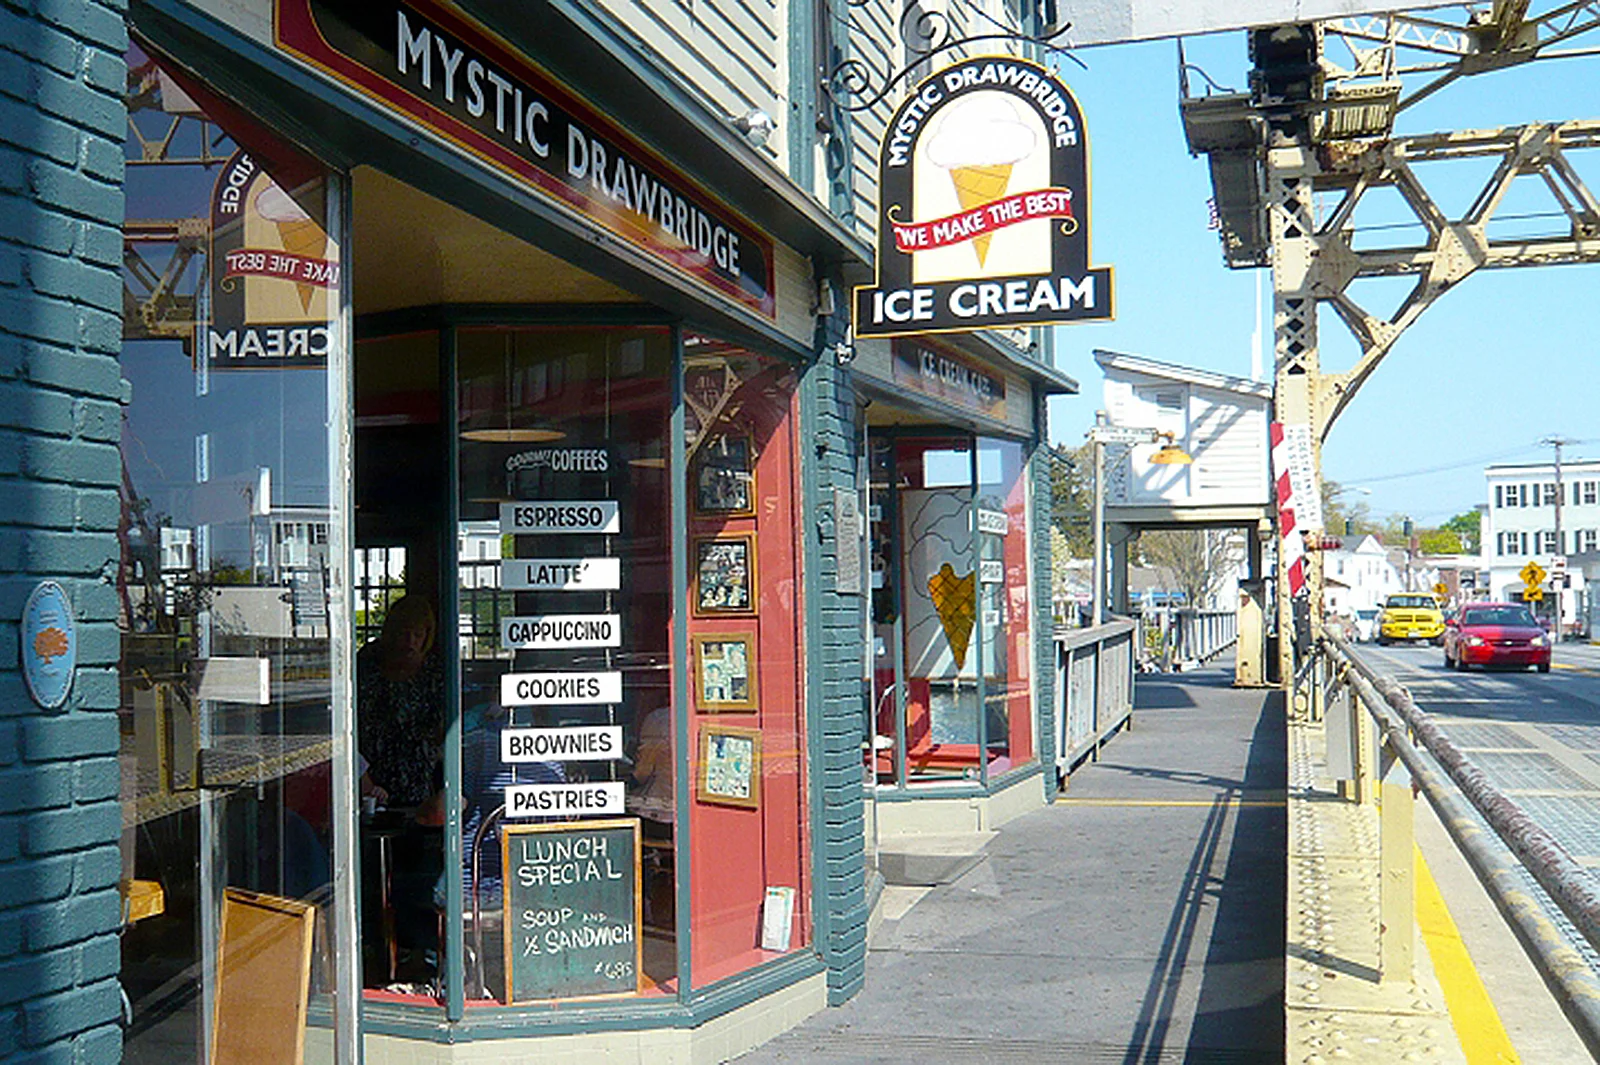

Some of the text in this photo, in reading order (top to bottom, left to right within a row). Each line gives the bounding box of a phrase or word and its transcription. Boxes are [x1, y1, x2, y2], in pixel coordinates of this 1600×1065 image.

[888, 64, 1078, 167] MYSTIC DRAWBRIDGE
[397, 10, 742, 278] MYSTIC DRAWBRIDGE
[900, 191, 1068, 247] WE MAKE THE BEST
[872, 275, 1096, 324] ICE CREAM
[552, 449, 609, 471] COFFEES
[514, 507, 603, 526] ESPRESSO
[508, 620, 612, 643] CAPPUCCINO
[516, 677, 601, 700] COOKIES
[509, 732, 613, 757] BROWNIES
[513, 789, 608, 812] PASTRIES
[521, 836, 608, 864] LUNCH
[517, 859, 623, 887] SPECIAL
[521, 906, 574, 930] SOUP
